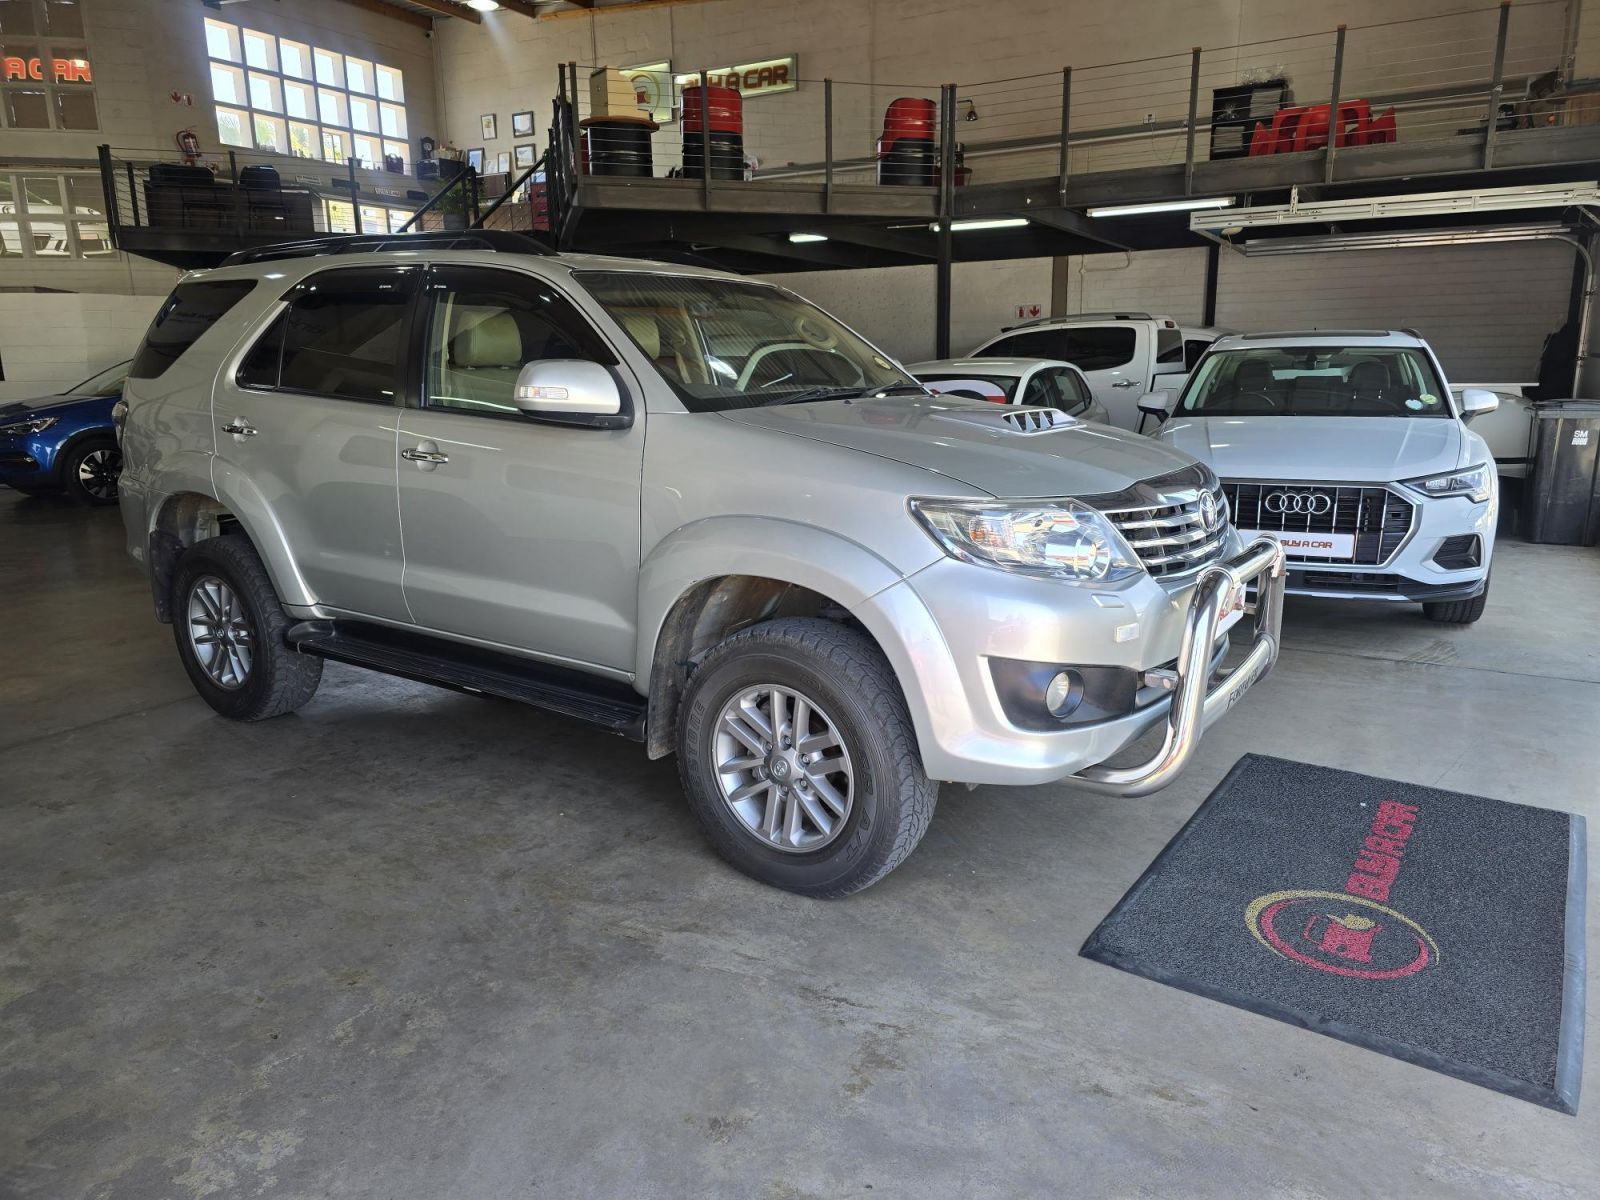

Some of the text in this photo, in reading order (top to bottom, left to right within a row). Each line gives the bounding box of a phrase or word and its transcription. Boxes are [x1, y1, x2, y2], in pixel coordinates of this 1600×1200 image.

[28, 57, 91, 82] CAR
[743, 64, 789, 89] CAR
[1280, 539, 1301, 548] BUY
[1311, 541, 1333, 549] CAR
